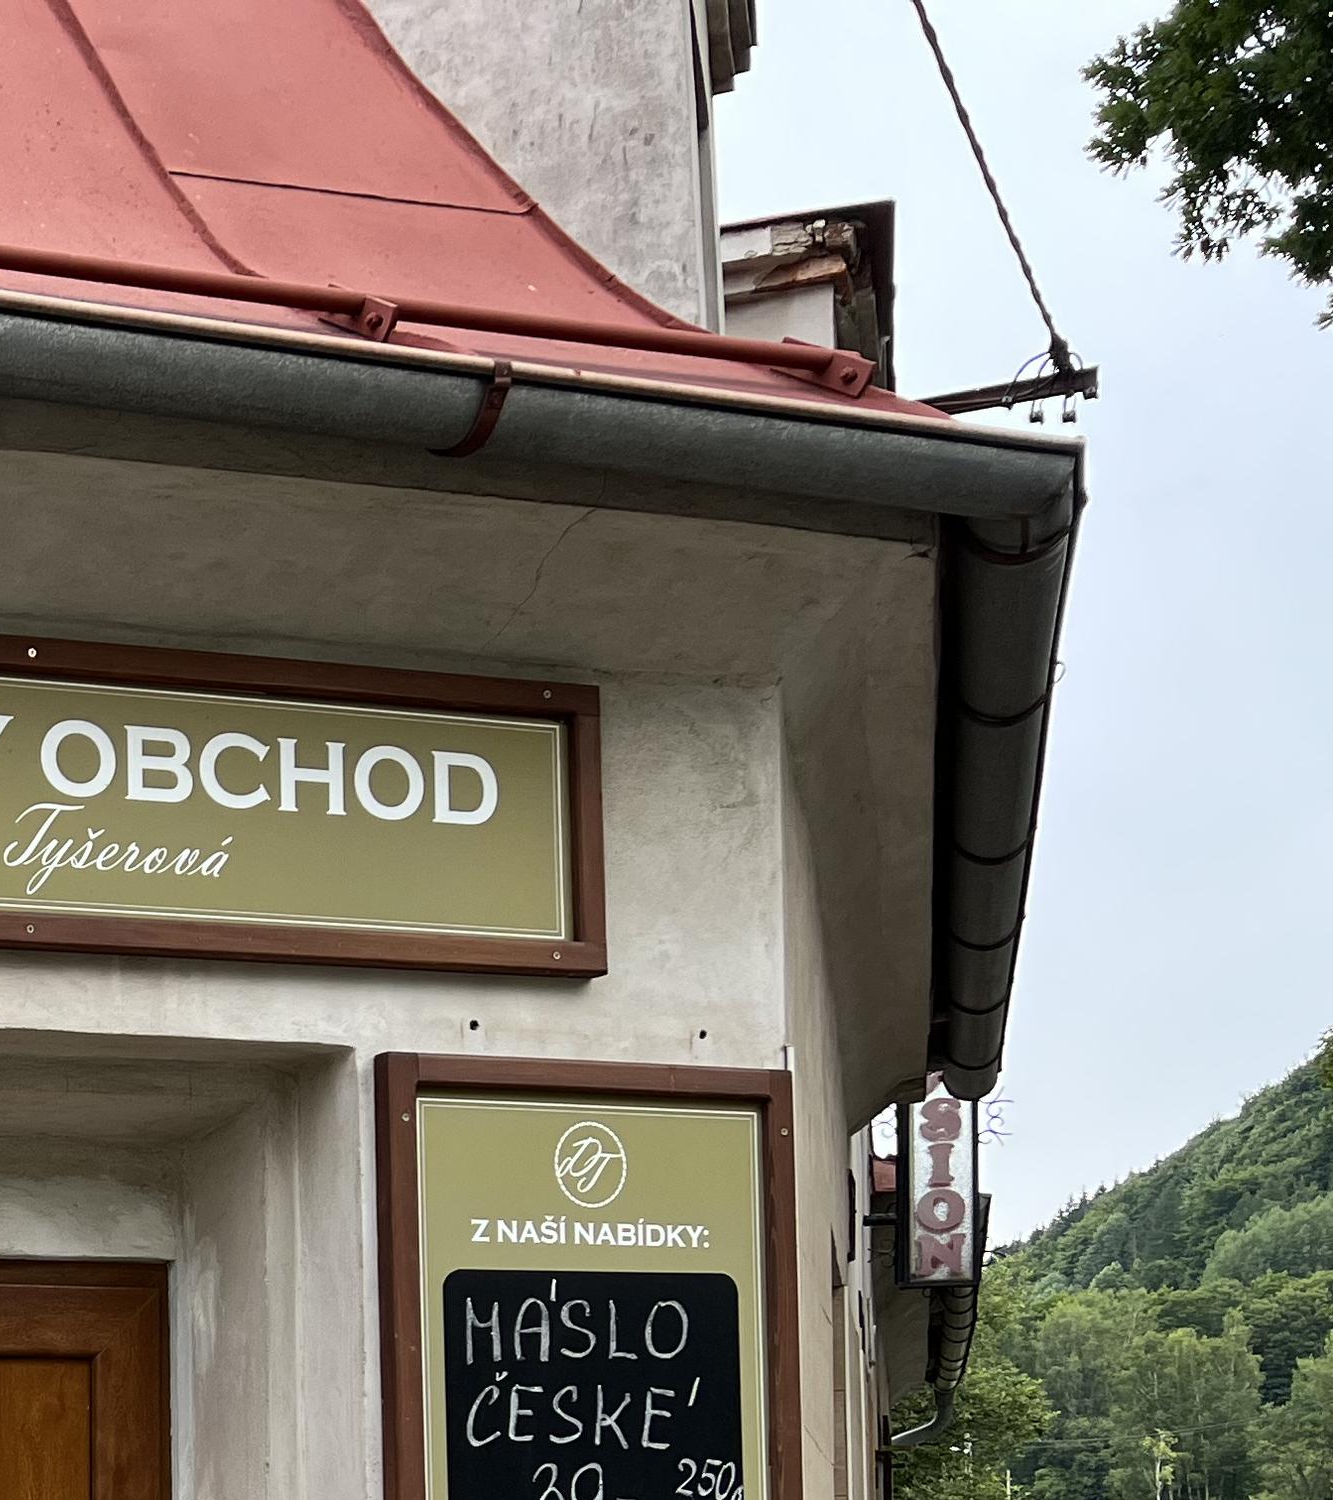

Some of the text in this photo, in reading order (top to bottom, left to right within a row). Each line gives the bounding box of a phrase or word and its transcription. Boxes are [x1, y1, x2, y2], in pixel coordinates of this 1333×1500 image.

[40, 719, 499, 826] OBCHOD
[3, 802, 235, 894] Tyšerová
[916, 1071, 966, 1277] SION
[470, 1215, 711, 1249] Z NAŠÍ NABÍDKY:
[465, 1278, 689, 1365] MÁSLO
[465, 1370, 701, 1449] ČESKÉ
